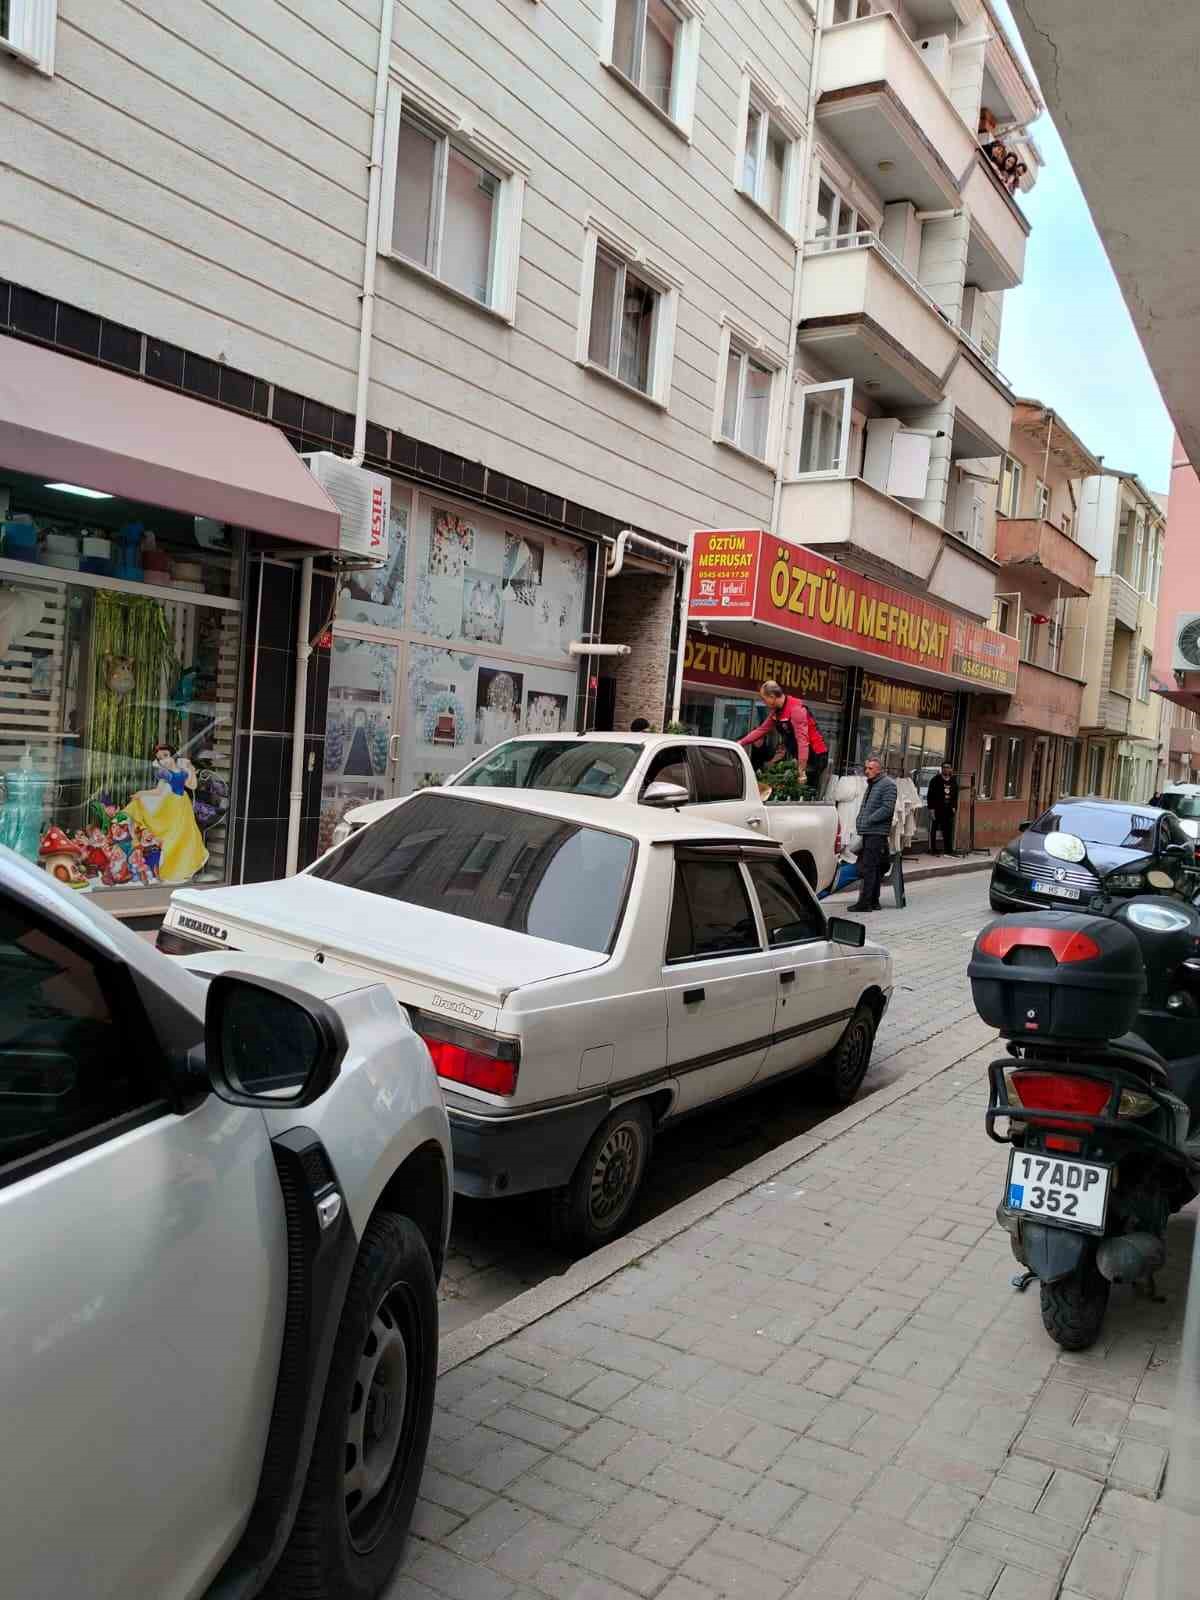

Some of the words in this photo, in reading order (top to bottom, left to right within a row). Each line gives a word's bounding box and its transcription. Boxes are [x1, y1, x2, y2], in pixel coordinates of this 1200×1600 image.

[371, 488, 382, 547] VESTEL
[708, 534, 745, 551] ÖZTÜM
[699, 553, 752, 570] MEFRUŞAT
[770, 547, 855, 632] ÖZTÜM
[858, 595, 948, 662] MEFRUŞAT
[750, 655, 827, 694] MEFRUŞAT
[431, 992, 484, 1021] Broadway
[1022, 1157, 1099, 1192] 17ADP
[1029, 1186, 1079, 1217] 352
